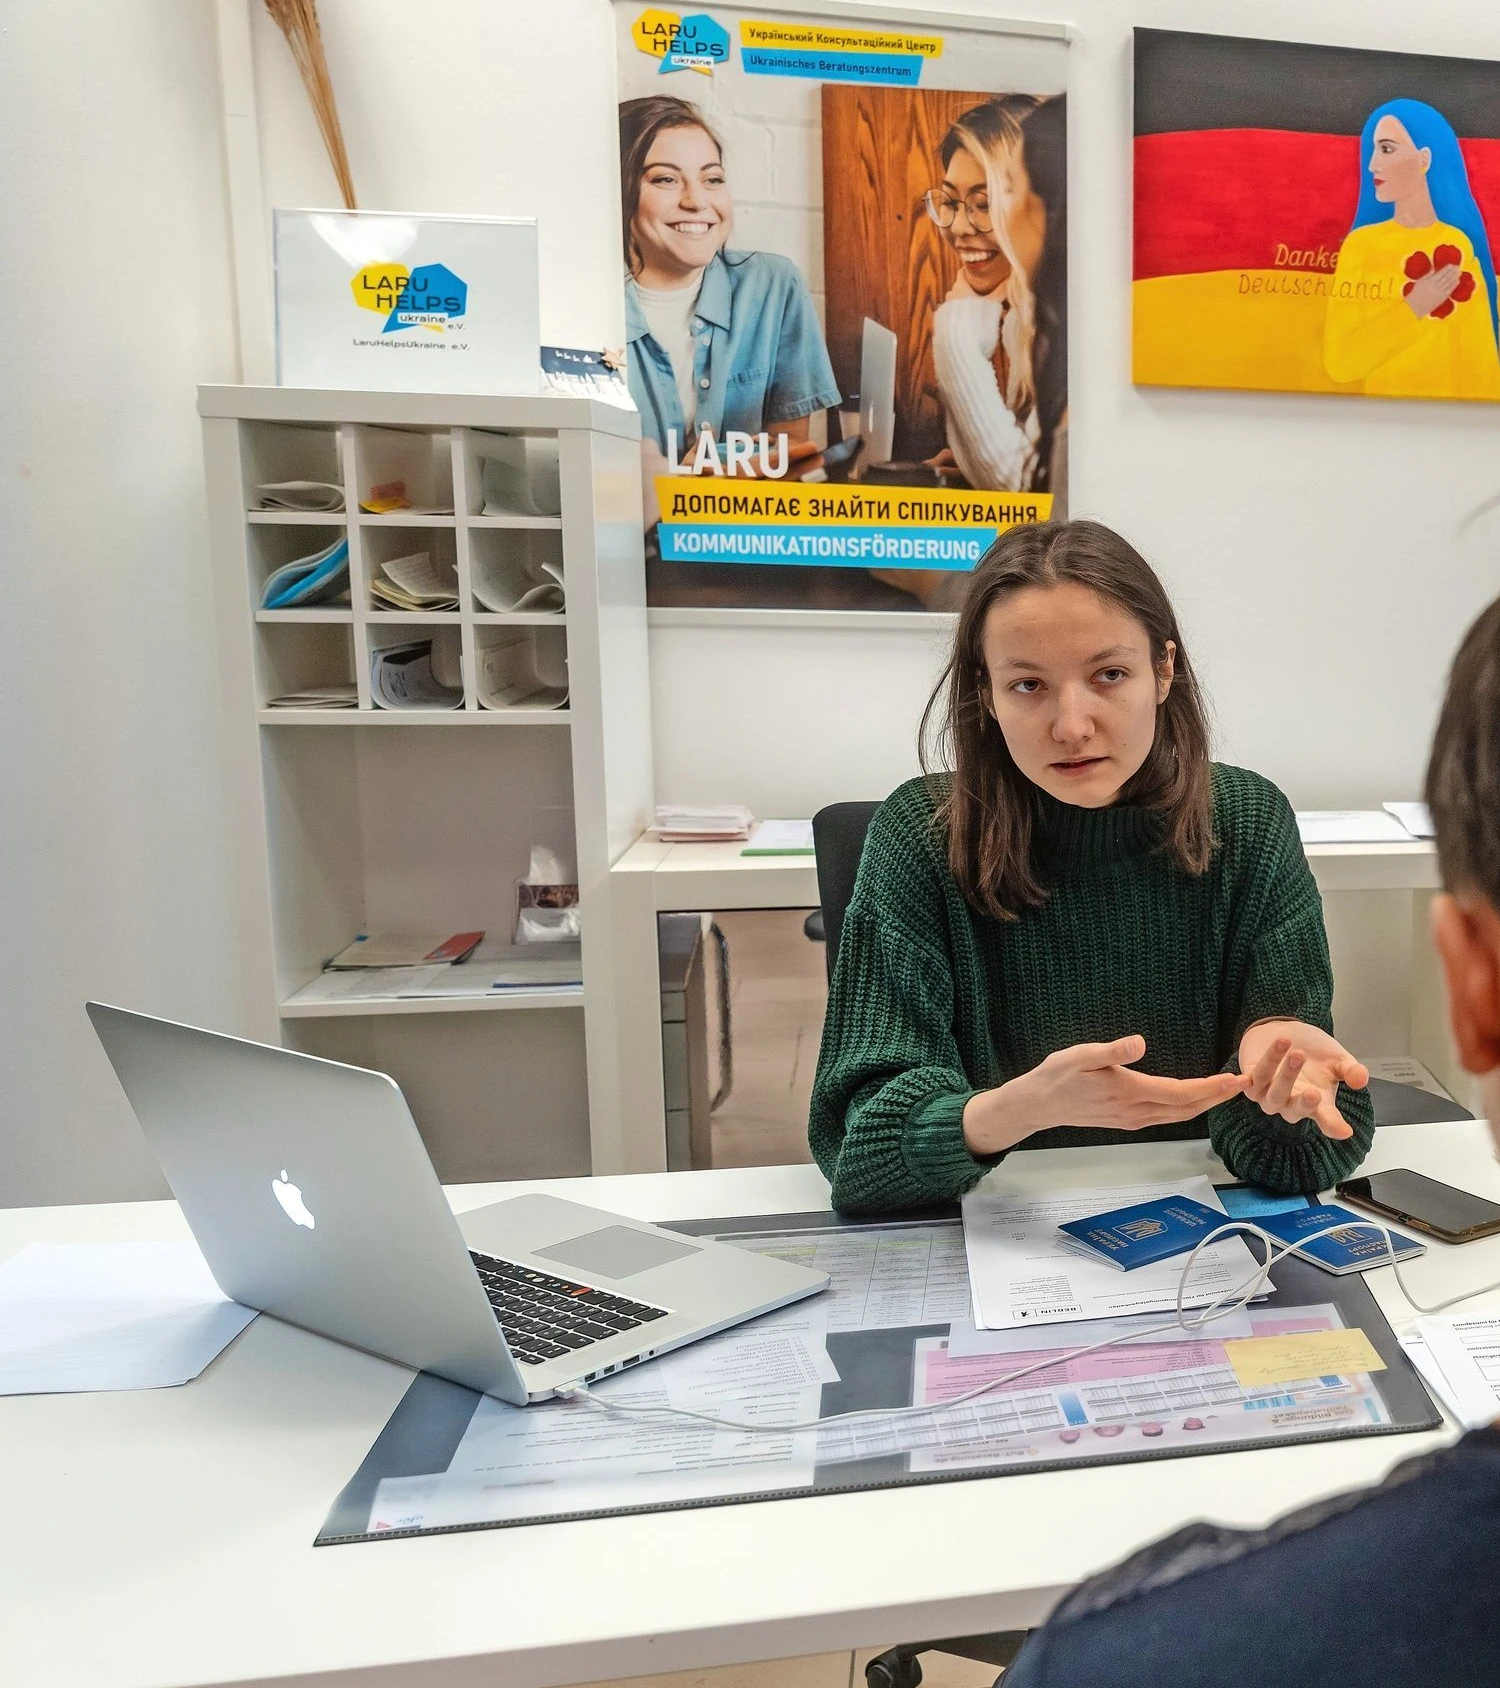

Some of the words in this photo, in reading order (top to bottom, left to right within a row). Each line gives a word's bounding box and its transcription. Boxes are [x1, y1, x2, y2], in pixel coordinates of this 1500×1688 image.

[642, 21, 697, 39] LARU
[653, 39, 724, 57] HELPS
[750, 28, 814, 45] Український
[817, 34, 904, 51] Консультаційний
[906, 39, 936, 54] Центр
[673, 57, 712, 67] ukraine
[750, 55, 816, 72] Ukrainisches
[818, 60, 912, 77] Beratungszentrum
[1274, 243, 1340, 269] Danke
[363, 274, 429, 293] LARU
[1238, 273, 1392, 301] Deutschland!
[376, 293, 461, 313] HELPS
[400, 313, 446, 324] ukraine
[352, 338, 446, 351] LaruHelpsUkraine
[667, 428, 789, 479] LARU
[672, 494, 801, 517] ДОПОМАГАЄ
[808, 495, 891, 520] ЗНАЙТИ
[898, 501, 1037, 523] СПІЛКУВАННЯ
[673, 531, 980, 561] KOMMUNIKATIONSFÖRDERUNG
